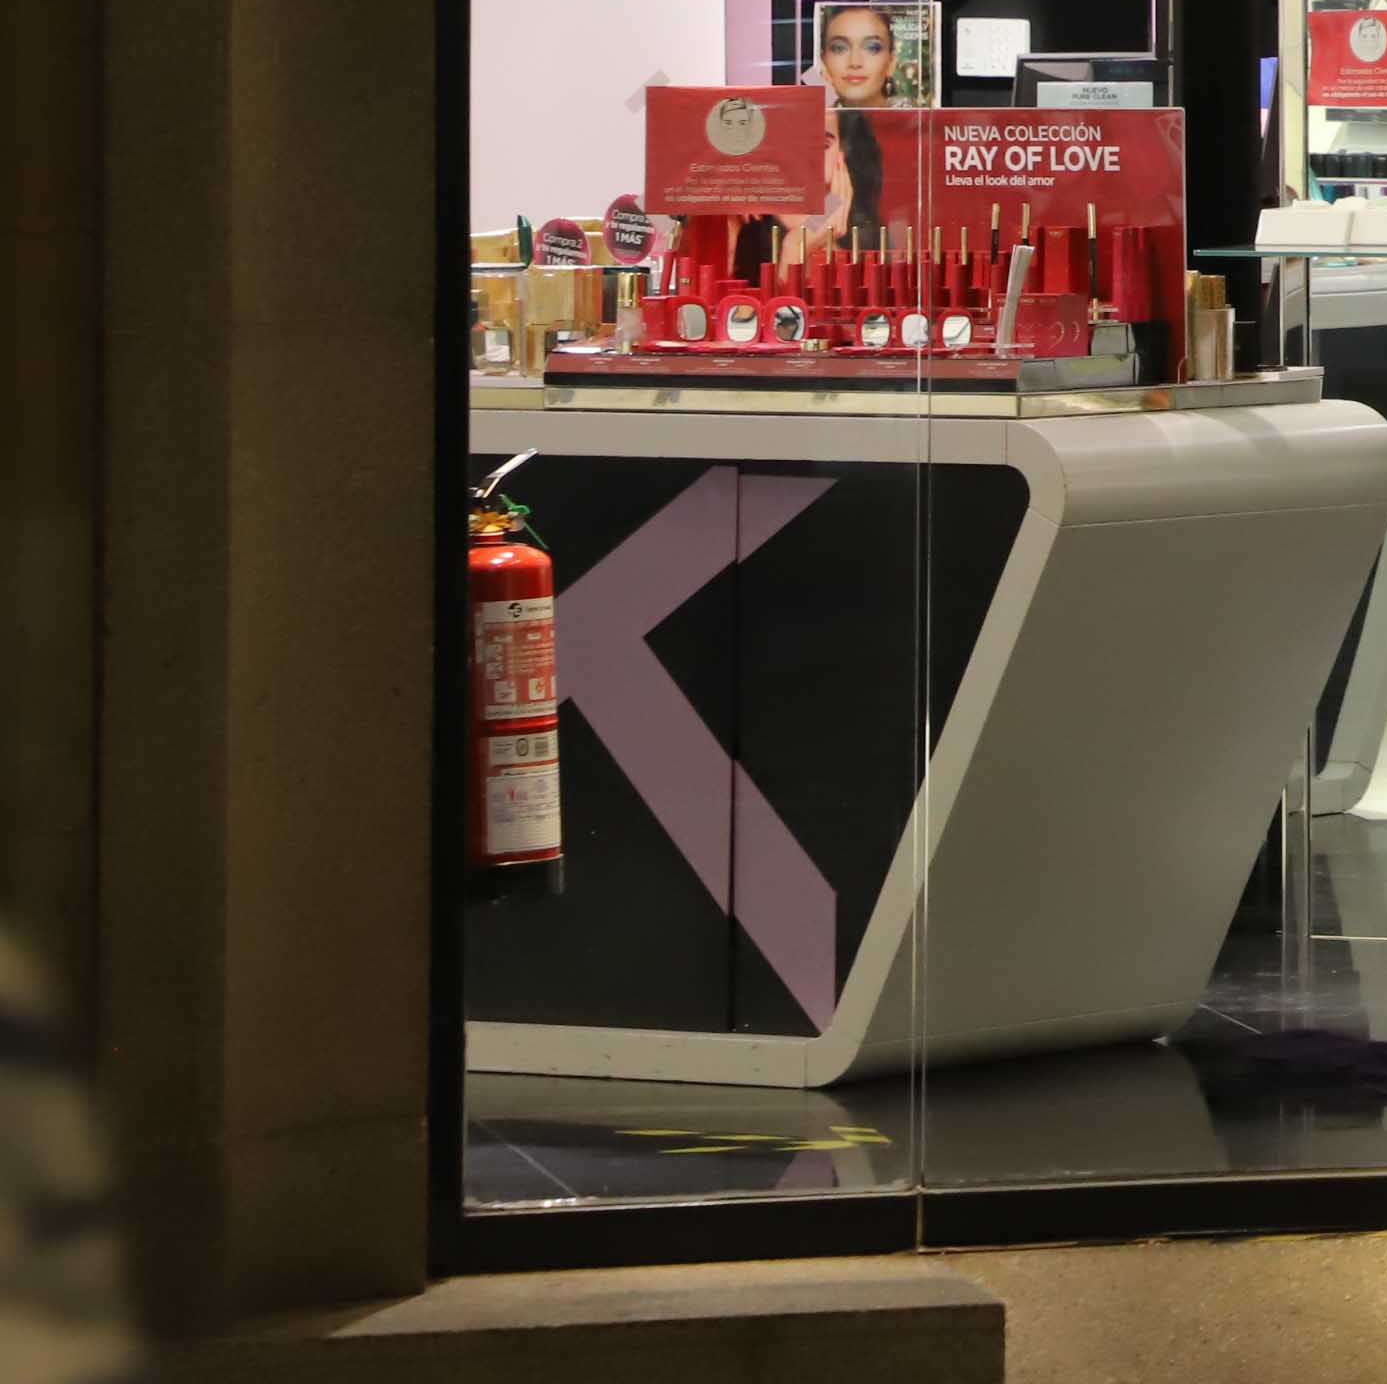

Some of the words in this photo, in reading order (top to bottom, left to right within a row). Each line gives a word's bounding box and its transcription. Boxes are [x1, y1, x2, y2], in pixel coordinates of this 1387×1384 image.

[944, 125, 1001, 142] NUEVA
[1003, 122, 1102, 142] COLECCIÓN
[945, 145, 999, 171] RAY
[1004, 145, 1043, 171] OF
[1050, 145, 1121, 172] LOVE
[945, 175, 973, 186] Lleva
[974, 175, 984, 186] el
[985, 175, 1008, 186] look
[1009, 175, 1027, 186] del
[1028, 177, 1055, 186] amor
